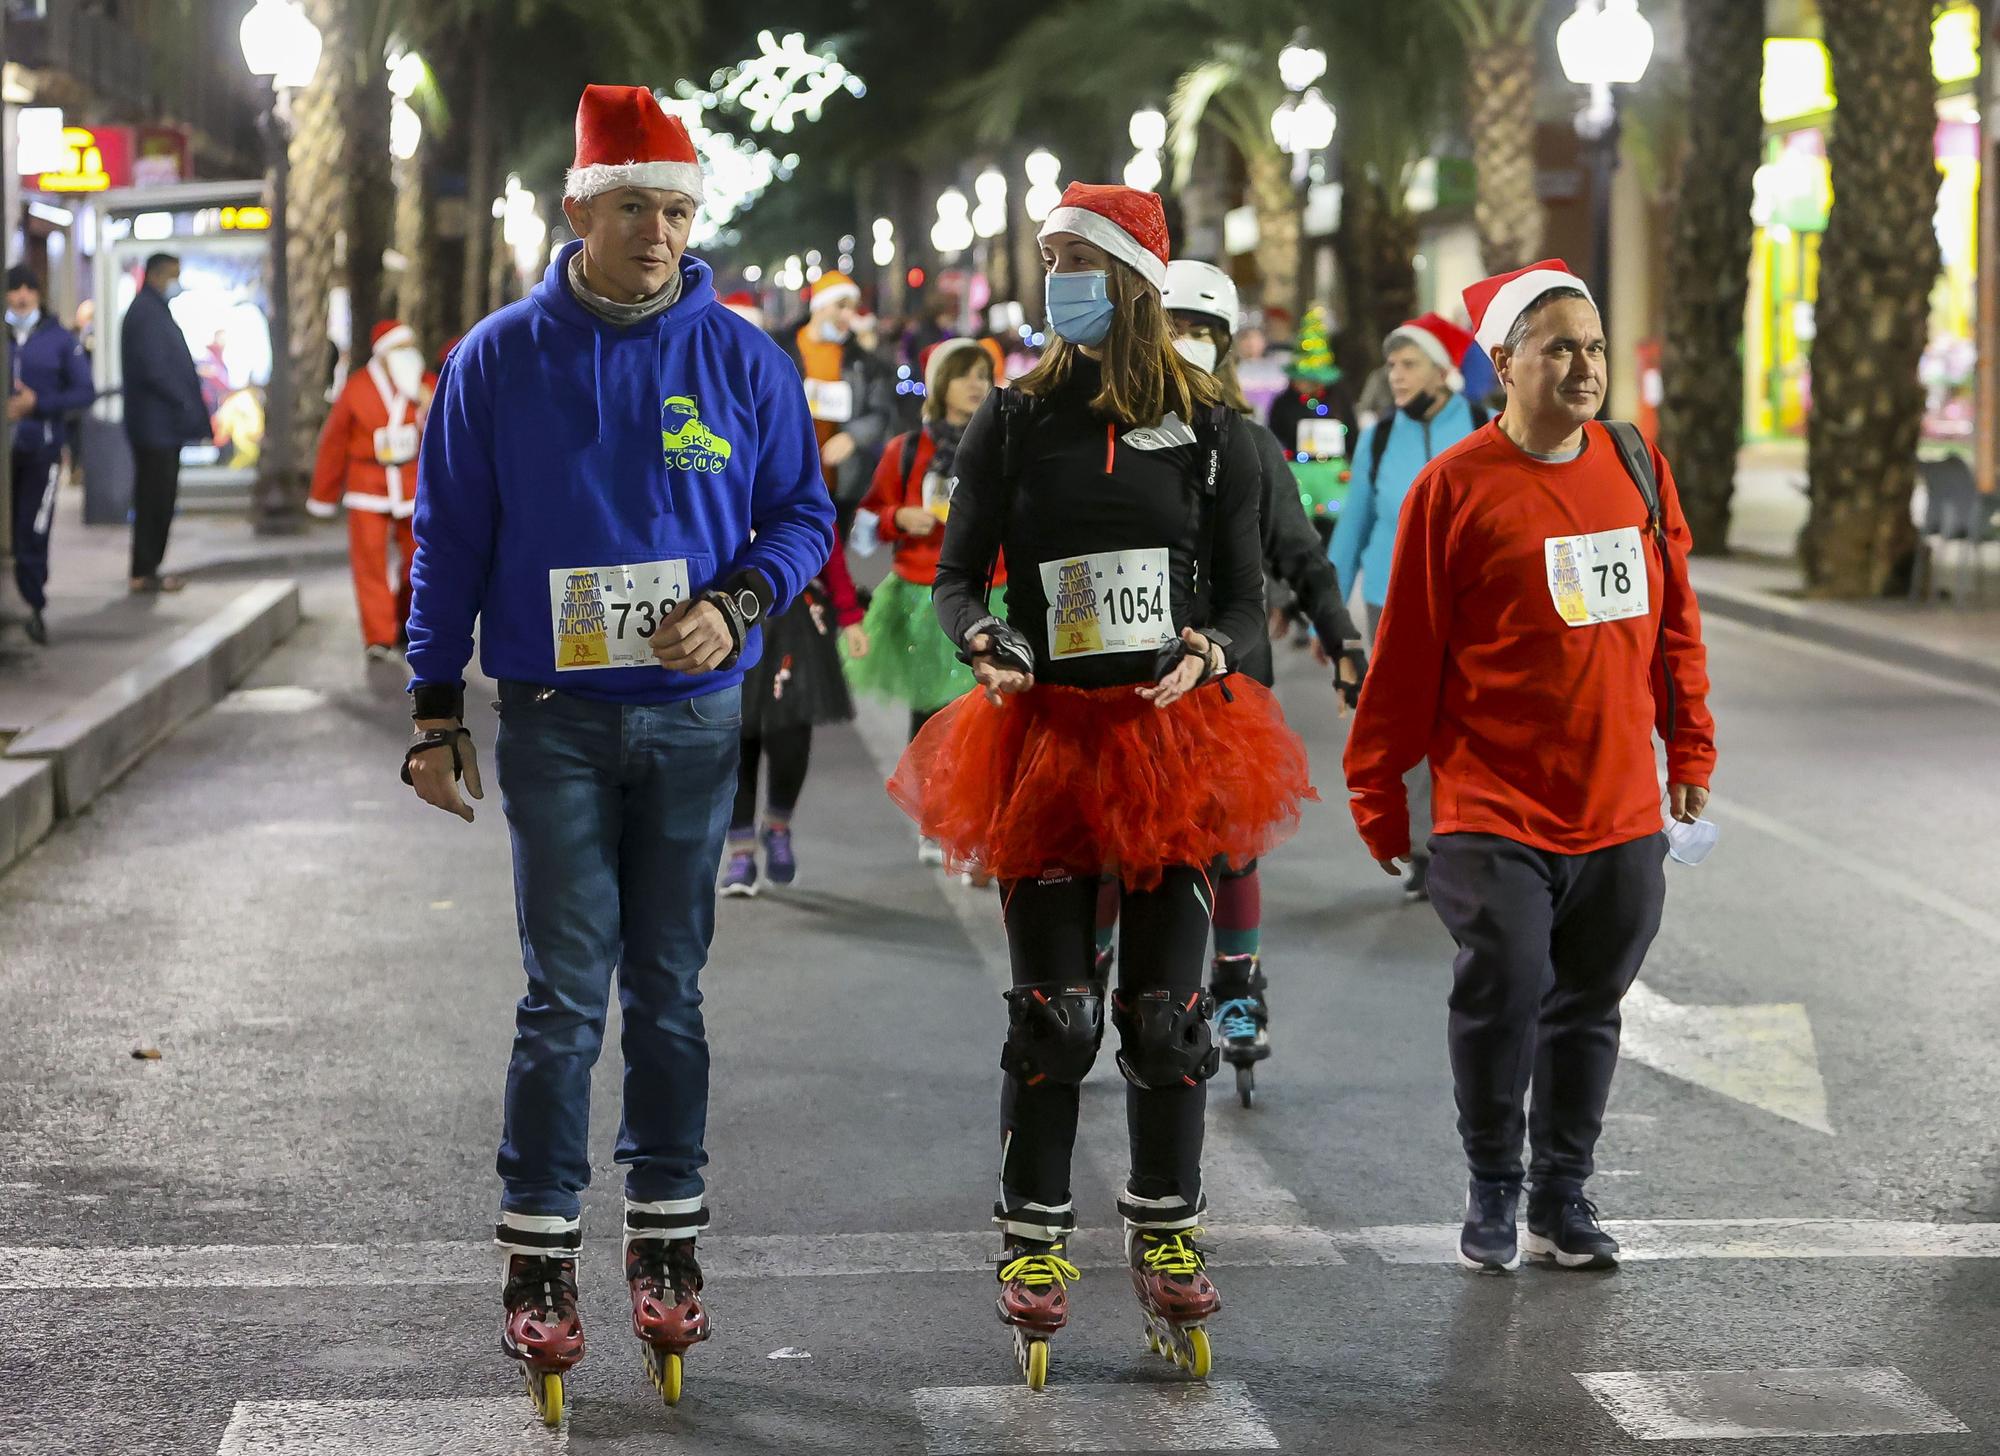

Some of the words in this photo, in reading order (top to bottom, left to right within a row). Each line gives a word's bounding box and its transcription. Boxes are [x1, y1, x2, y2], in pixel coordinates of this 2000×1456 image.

[681, 435, 713, 448] SK8
[1207, 449, 1218, 486] Quechua
[566, 572, 600, 590] CARRERA
[1592, 562, 1631, 597] 78
[1103, 586, 1164, 625] 1054
